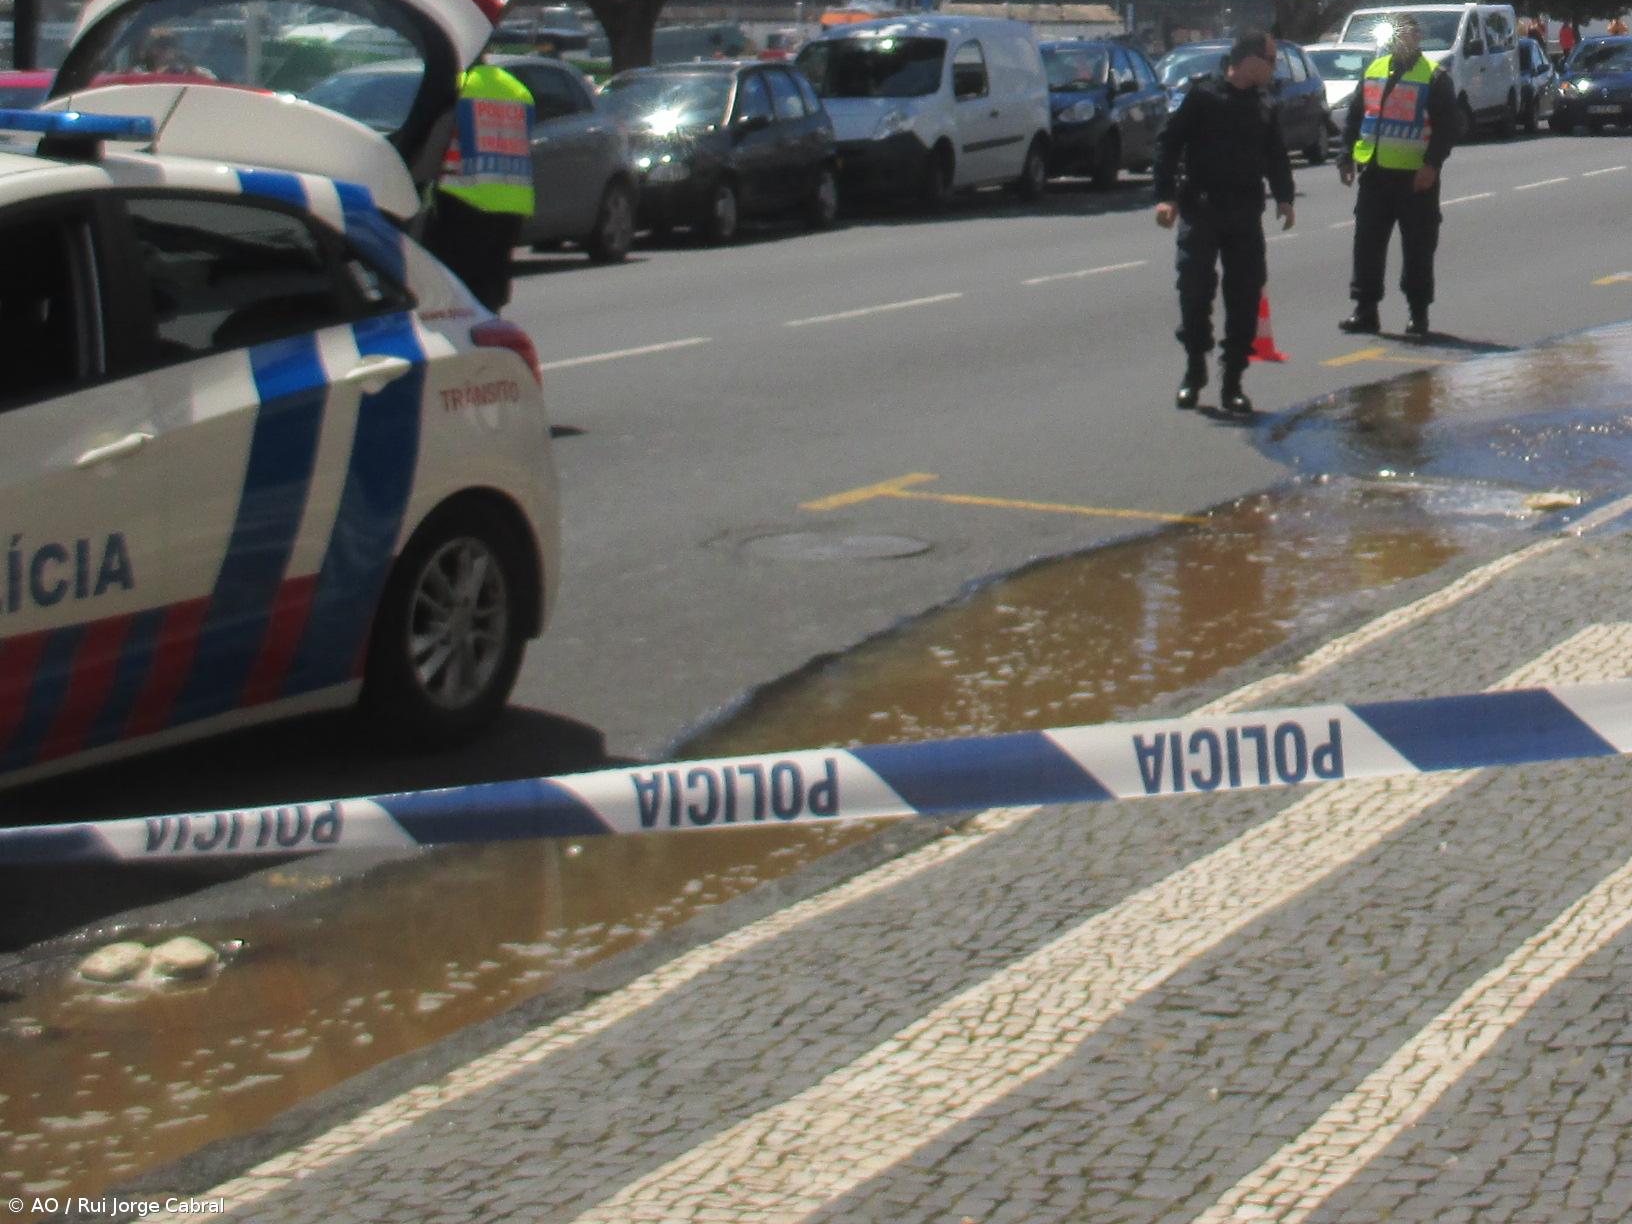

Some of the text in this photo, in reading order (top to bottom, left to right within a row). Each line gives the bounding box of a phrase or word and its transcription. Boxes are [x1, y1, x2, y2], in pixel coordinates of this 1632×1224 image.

[0, 532, 134, 614] ÍCIA
[630, 757, 840, 827] POLICIA
[1132, 718, 1345, 794] POLICIA
